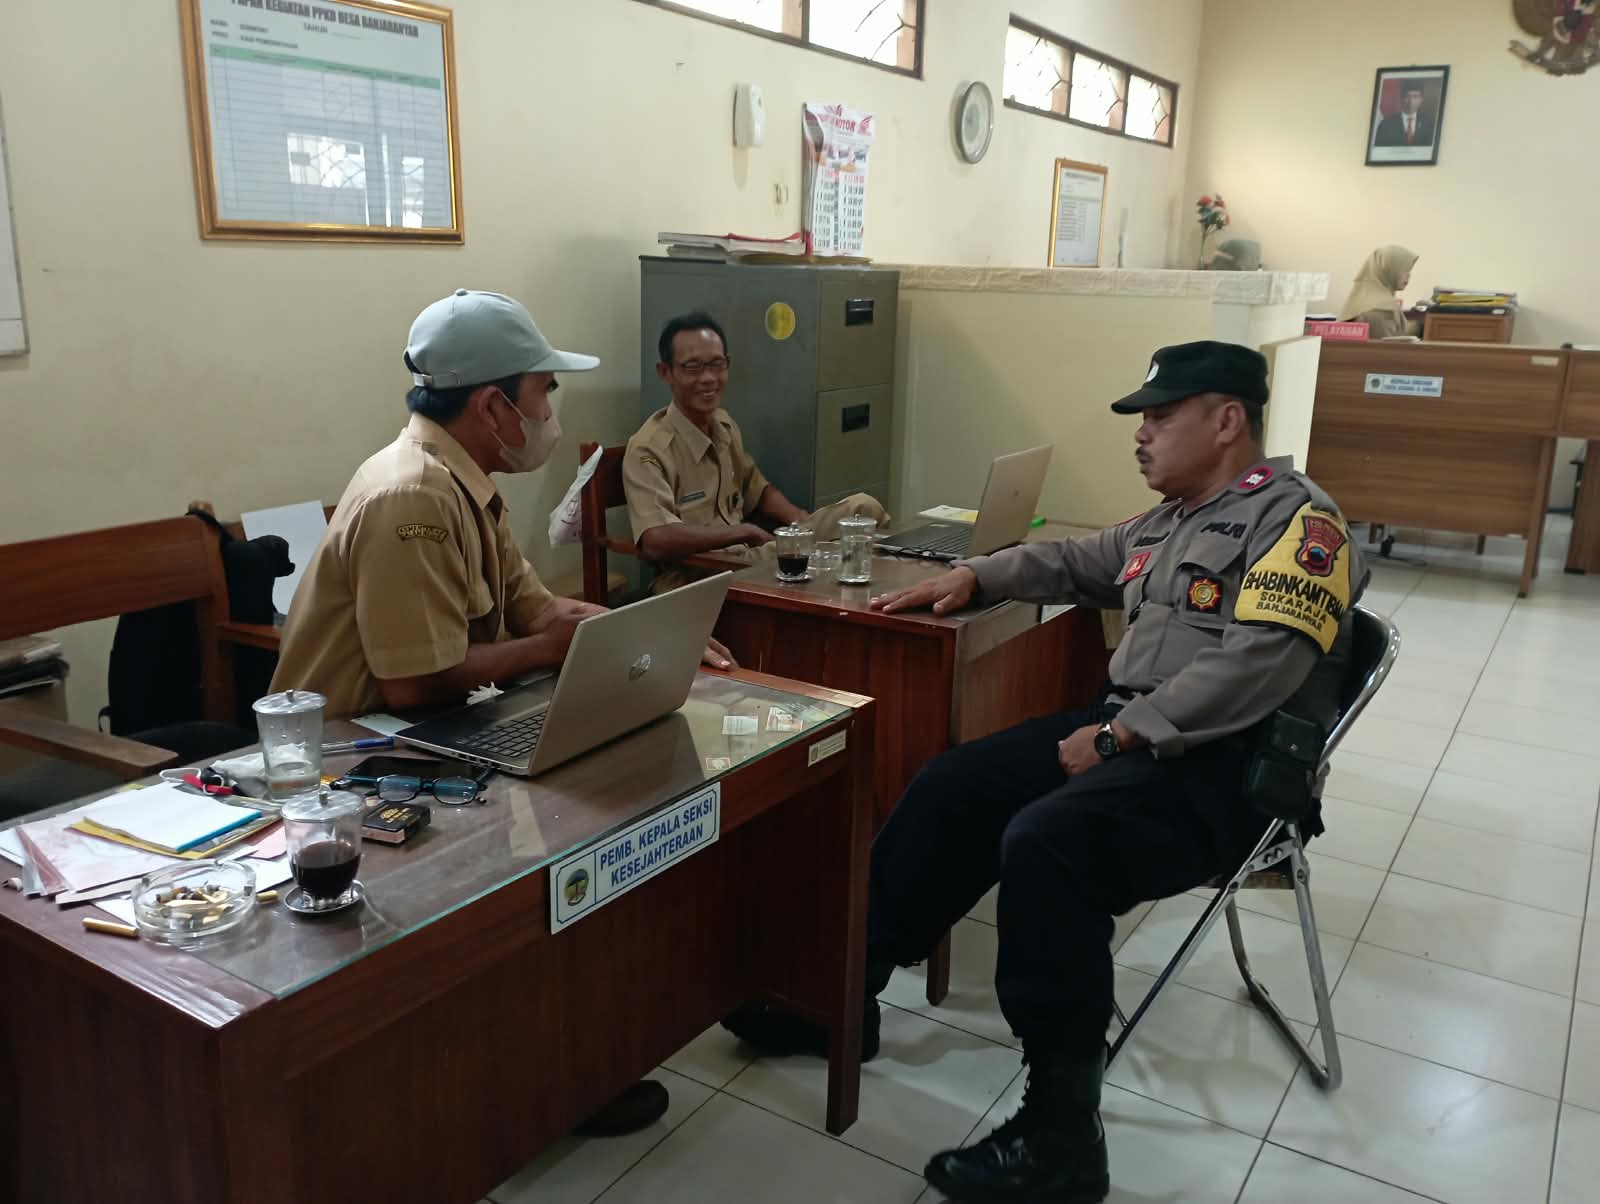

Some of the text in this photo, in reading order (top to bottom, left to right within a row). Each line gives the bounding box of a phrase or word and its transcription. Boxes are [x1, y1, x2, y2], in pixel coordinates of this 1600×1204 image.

[1260, 591, 1326, 624] SOKARAJA
[600, 797, 713, 871] PEMB. KEPALA SEKSI
[611, 823, 704, 887] KESEJAHTERAAN
